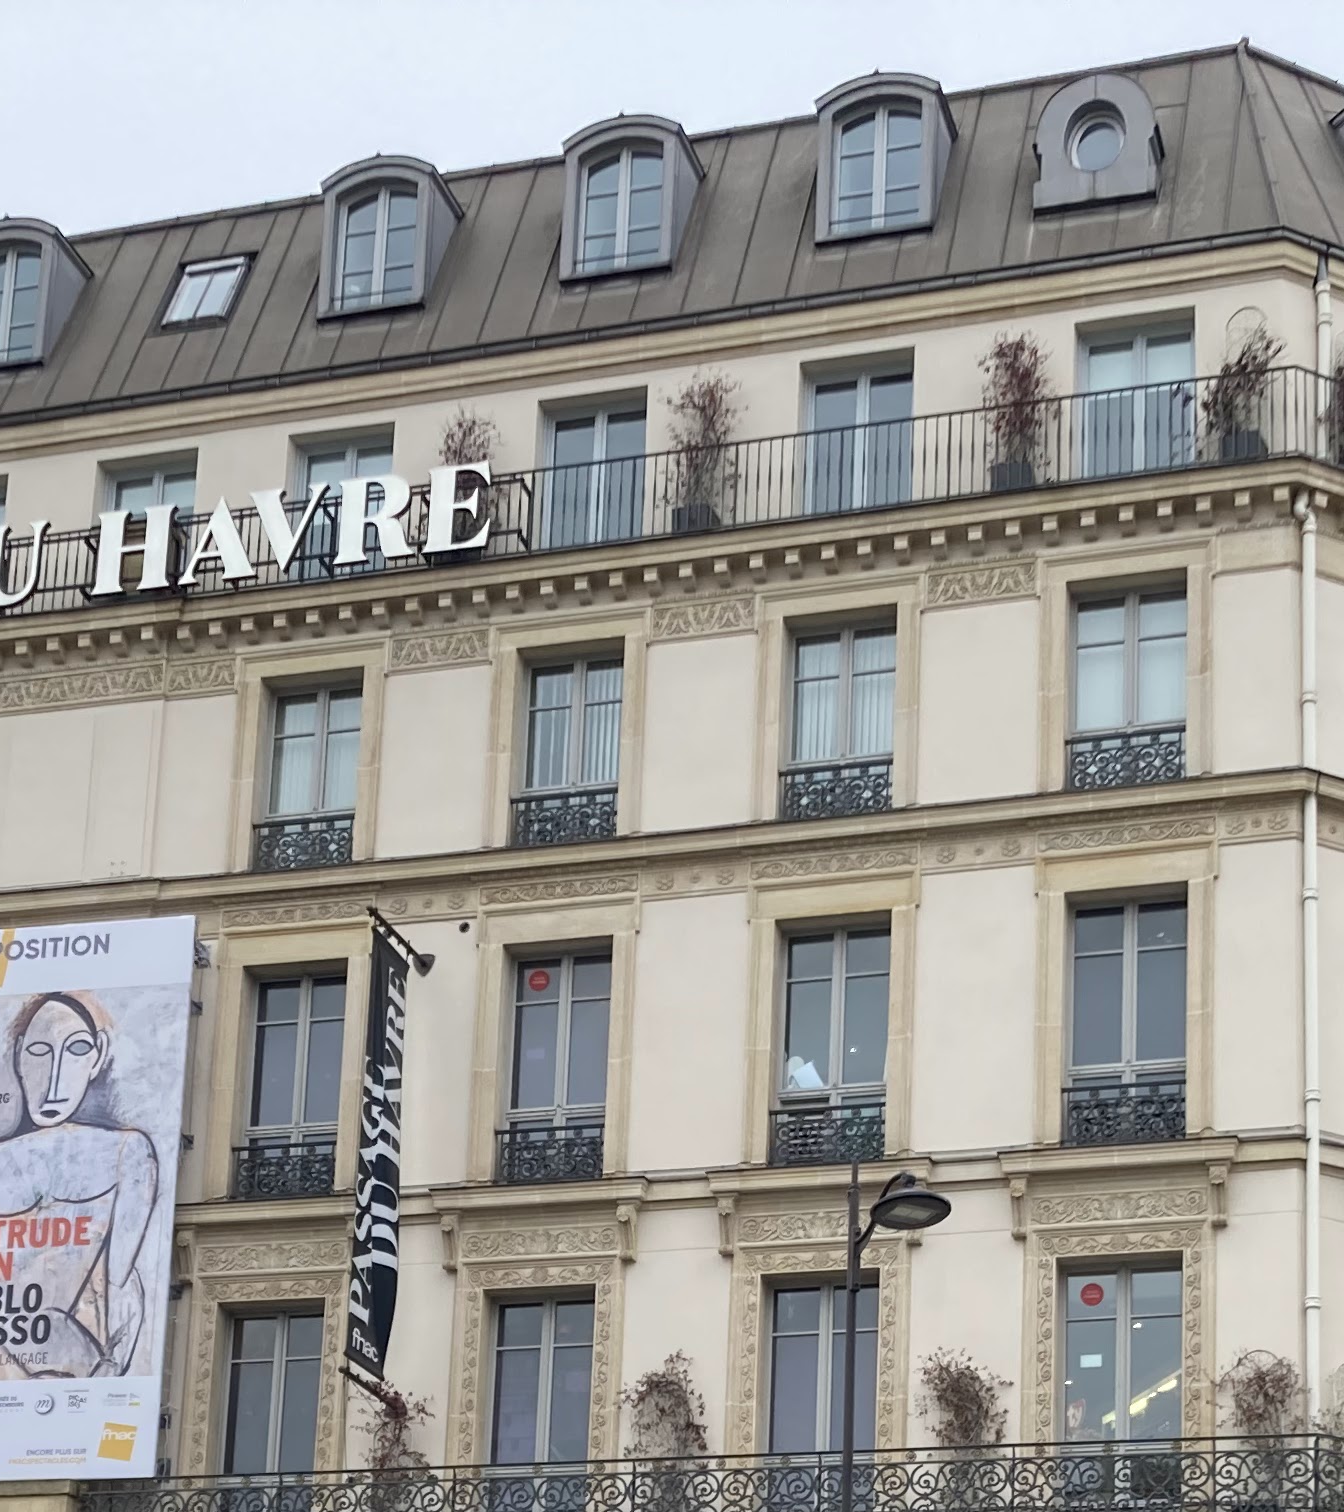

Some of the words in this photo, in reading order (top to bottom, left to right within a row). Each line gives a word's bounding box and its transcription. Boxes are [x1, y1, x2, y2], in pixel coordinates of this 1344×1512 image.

[92, 462, 492, 597] HAVRE
[374, 966, 409, 1159] HAVRE
[349, 1057, 388, 1325] PASSAGE
[370, 1164, 400, 1271] DU
[0, 1351, 48, 1366] LANGAGE
[351, 1327, 379, 1363] fnac
[102, 1428, 137, 1441] fnac
